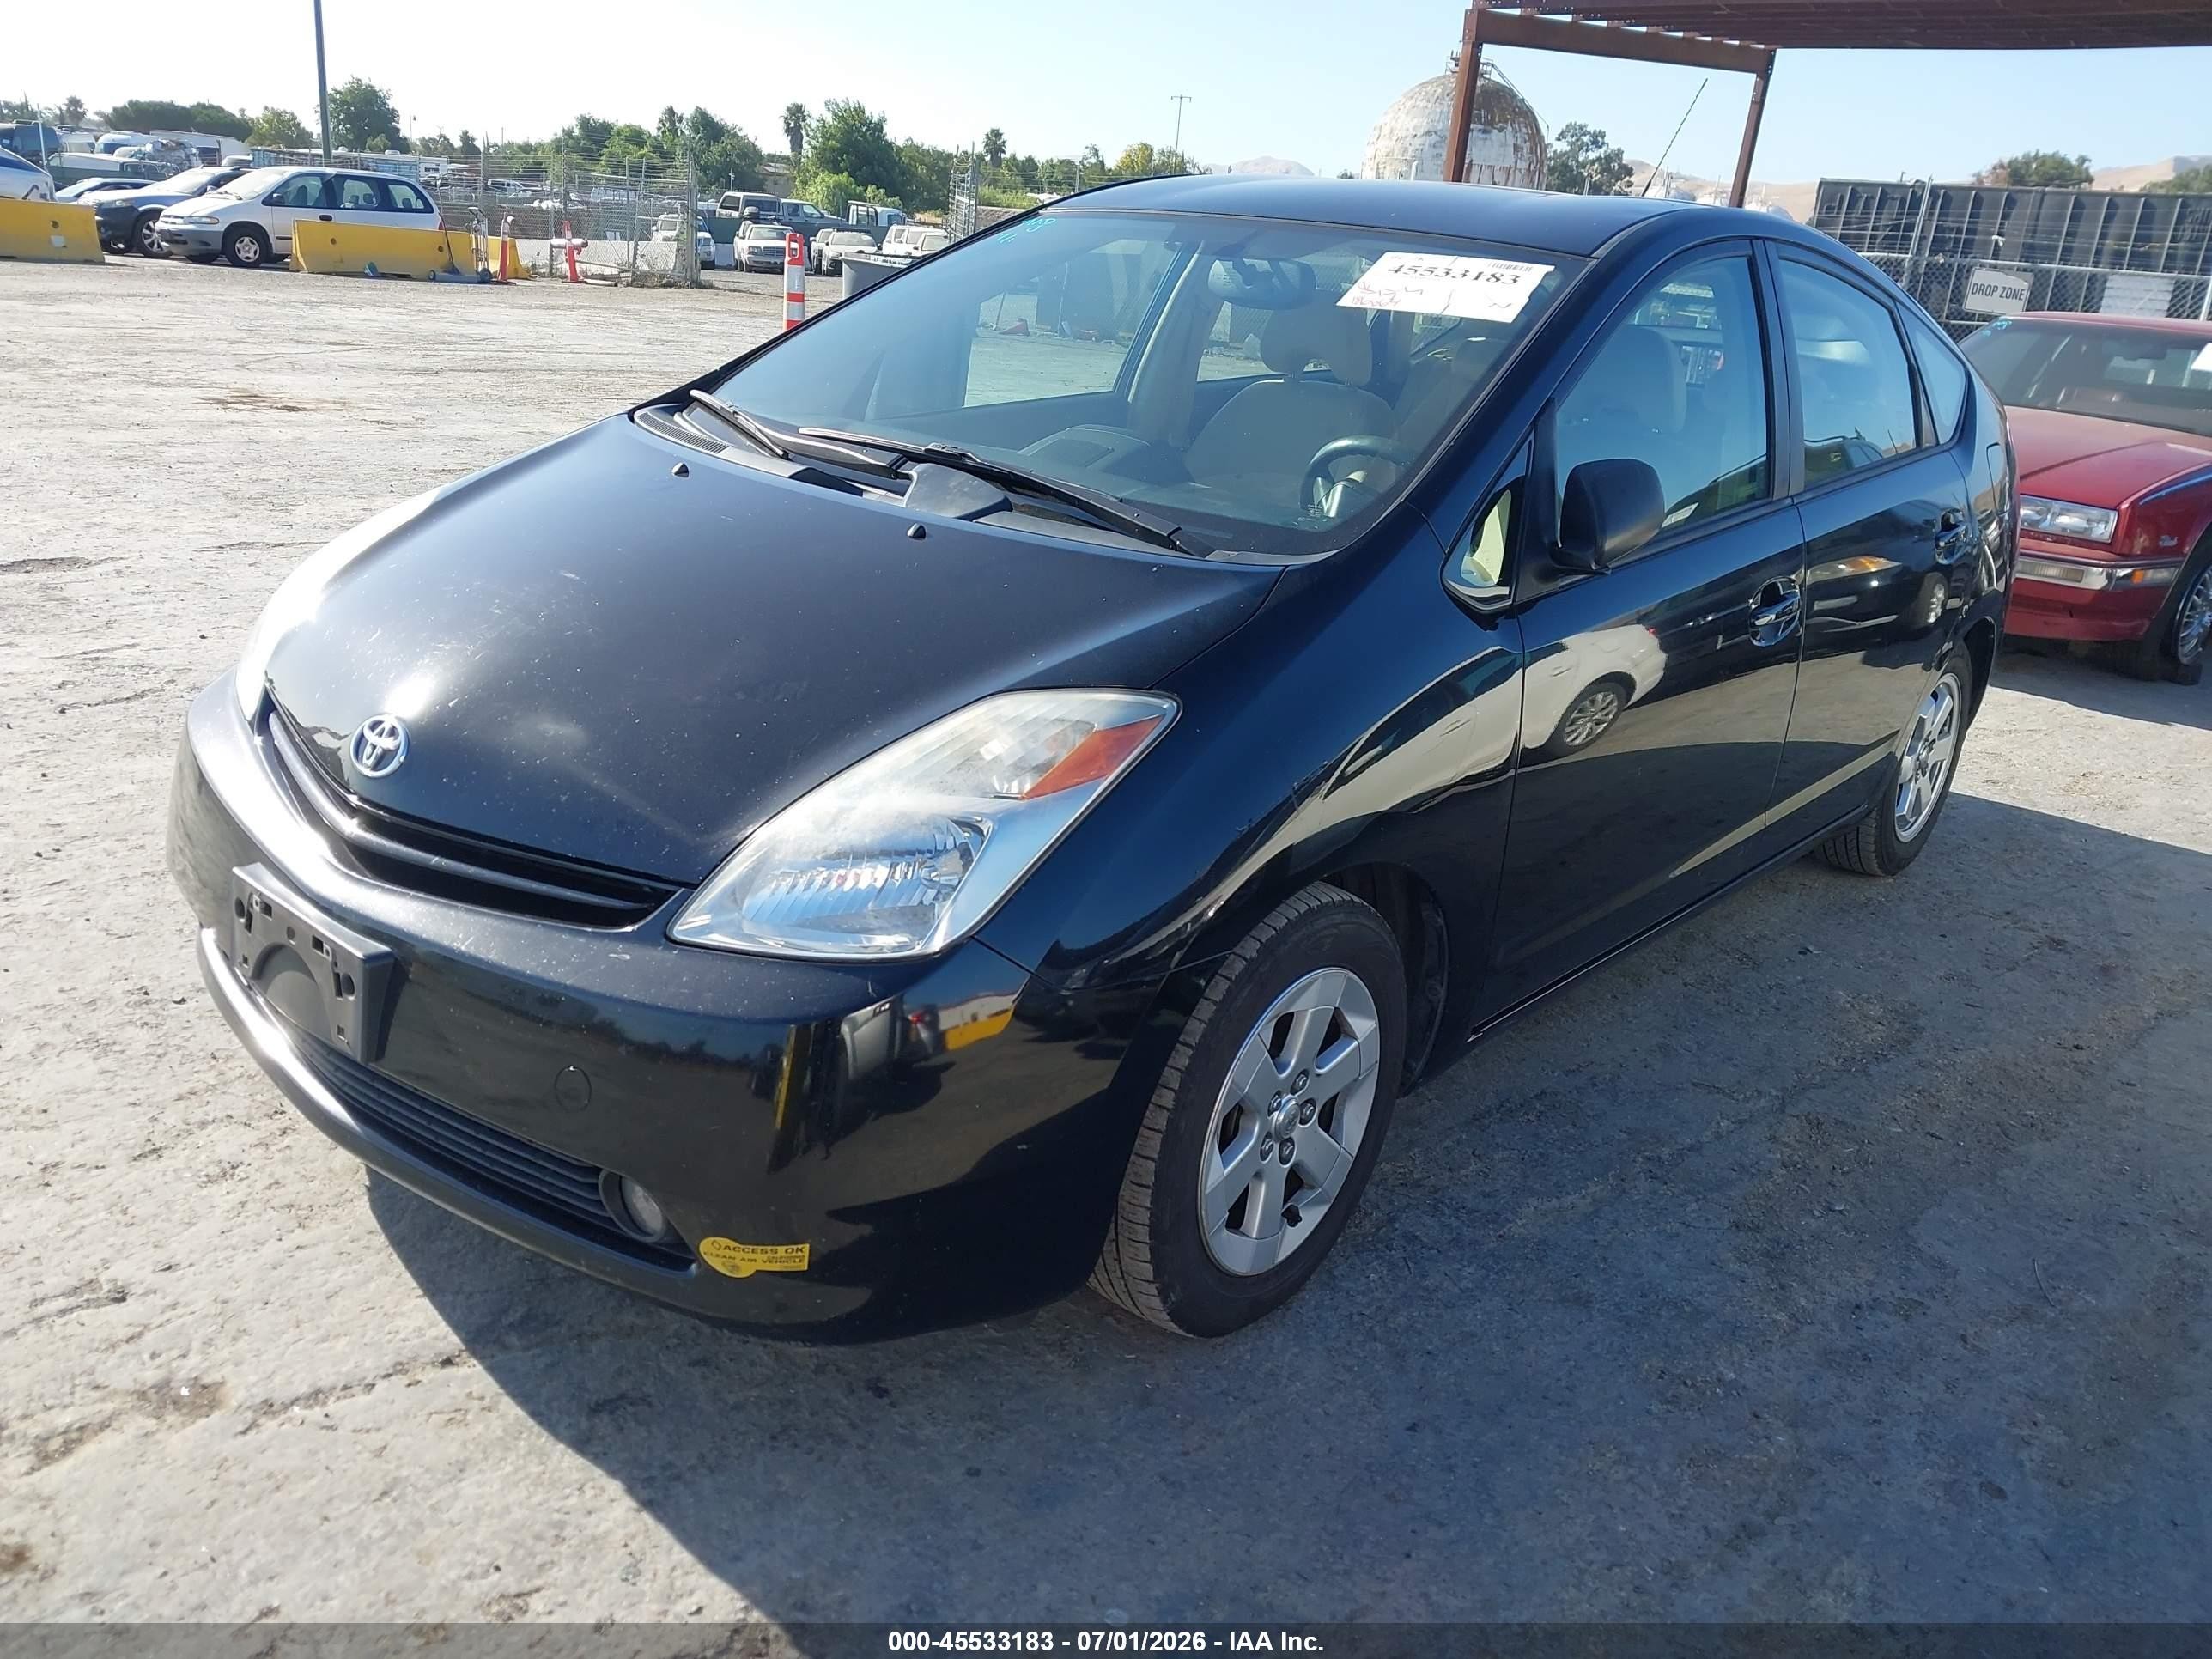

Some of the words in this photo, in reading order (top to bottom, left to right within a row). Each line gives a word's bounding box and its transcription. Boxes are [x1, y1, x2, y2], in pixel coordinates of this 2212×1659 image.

[1388, 264, 1521, 284] 45533183
[1972, 283, 1999, 297] DROP
[1999, 286, 2025, 301] ZONE
[703, 1251, 736, 1261] CLEAN
[723, 1245, 778, 1255] ACCESS
